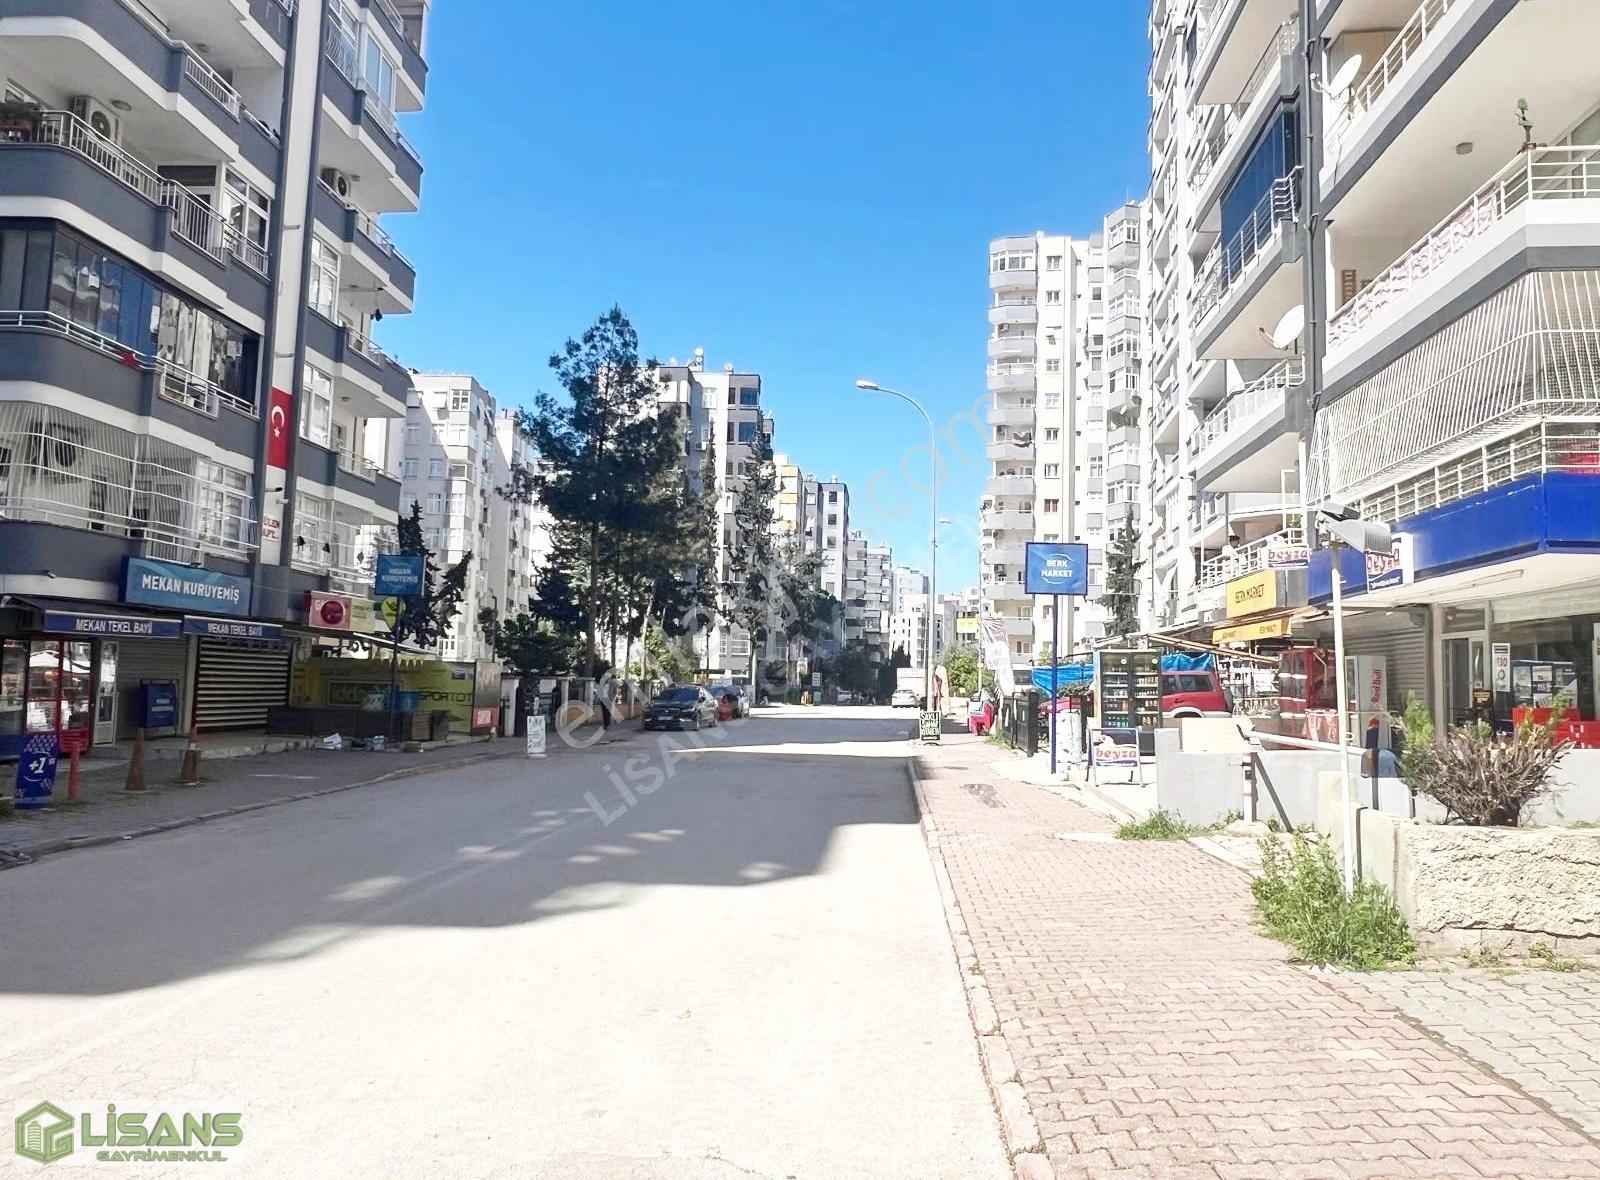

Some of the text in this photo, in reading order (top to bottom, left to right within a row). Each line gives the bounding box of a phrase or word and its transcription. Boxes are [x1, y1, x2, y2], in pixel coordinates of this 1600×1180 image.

[1046, 559, 1069, 567] BERK
[1040, 569, 1073, 578] MARKET
[141, 574, 240, 605] MEKAN KURUYEMİŞ
[75, 618, 106, 632] MEKAN
[107, 620, 132, 633] TEKEL
[207, 622, 230, 634] MEKAN
[230, 624, 248, 636] TEKEL
[1095, 747, 1137, 760] beyza
